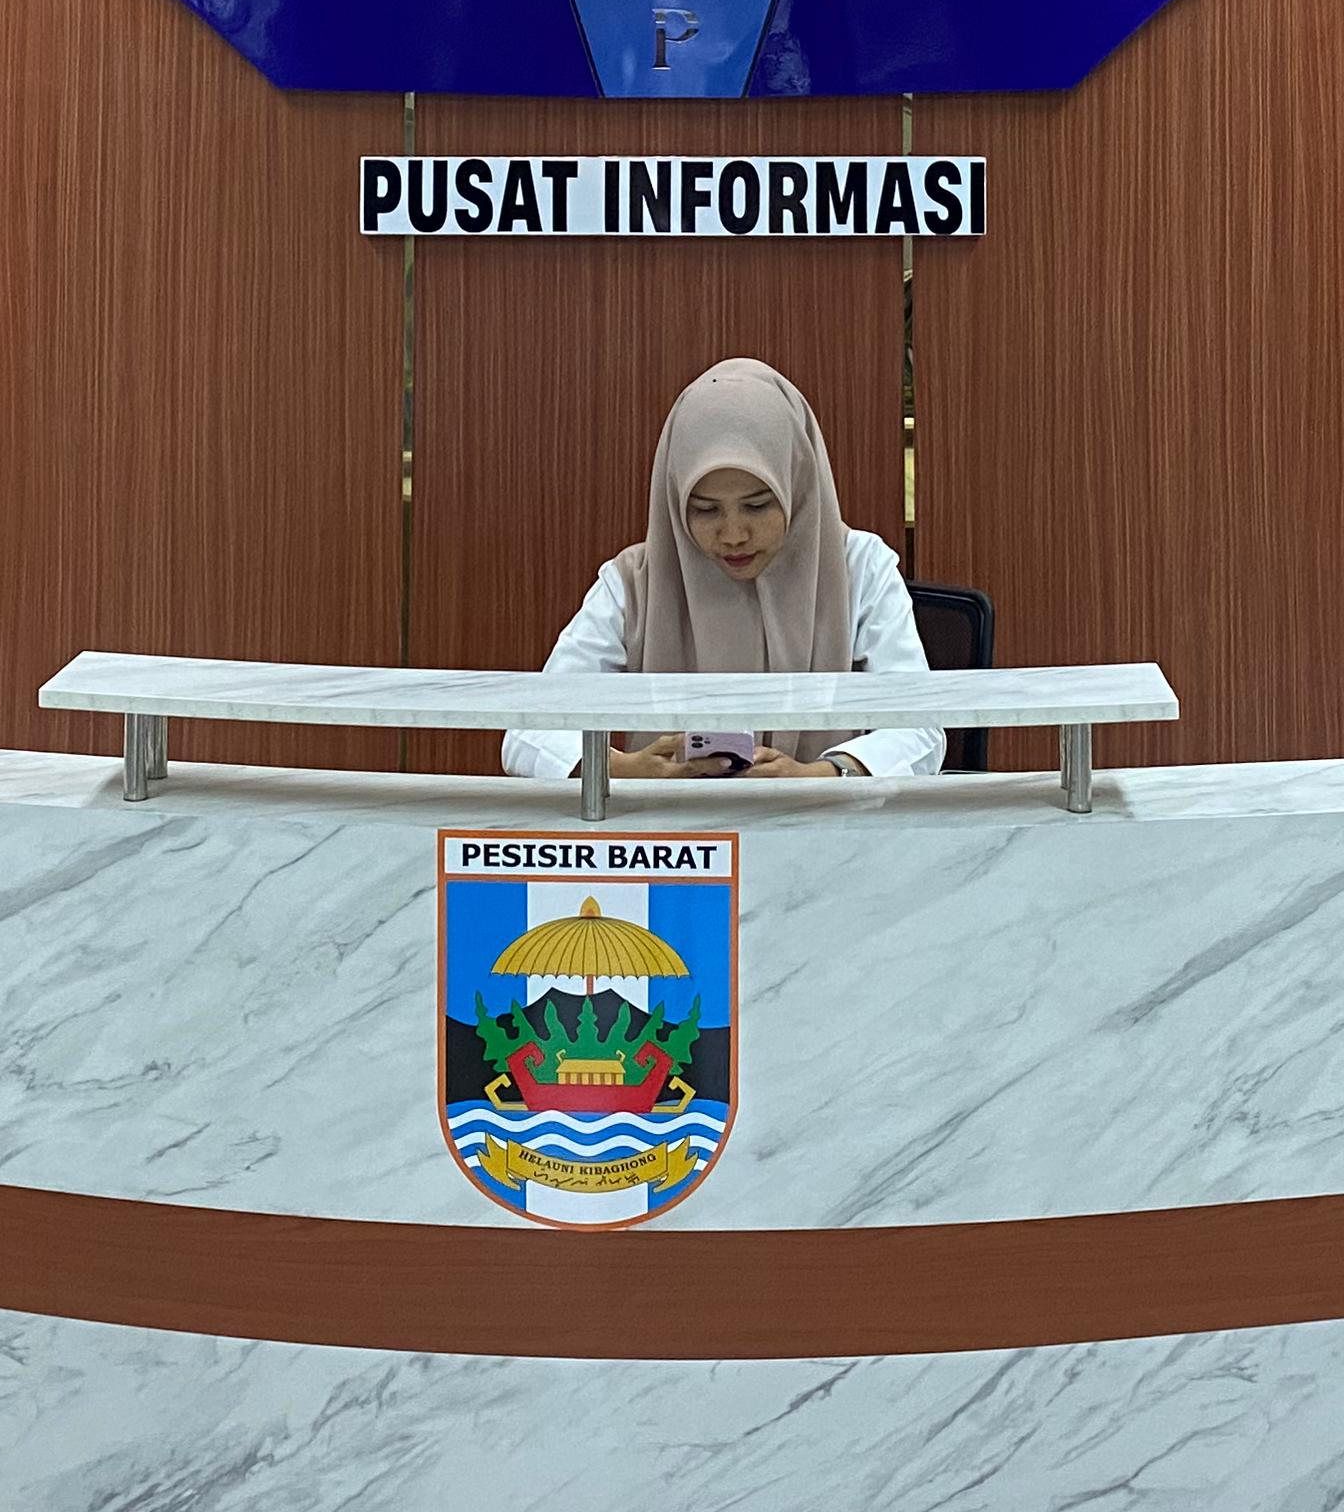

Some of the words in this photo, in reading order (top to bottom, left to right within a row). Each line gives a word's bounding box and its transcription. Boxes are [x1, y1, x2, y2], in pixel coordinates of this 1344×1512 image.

[364, 159, 578, 232] PUSAT
[605, 161, 985, 234] INFORMASI
[463, 844, 597, 868] PESISIR
[609, 846, 717, 869] BARAT
[518, 1150, 574, 1174] HELAUNI
